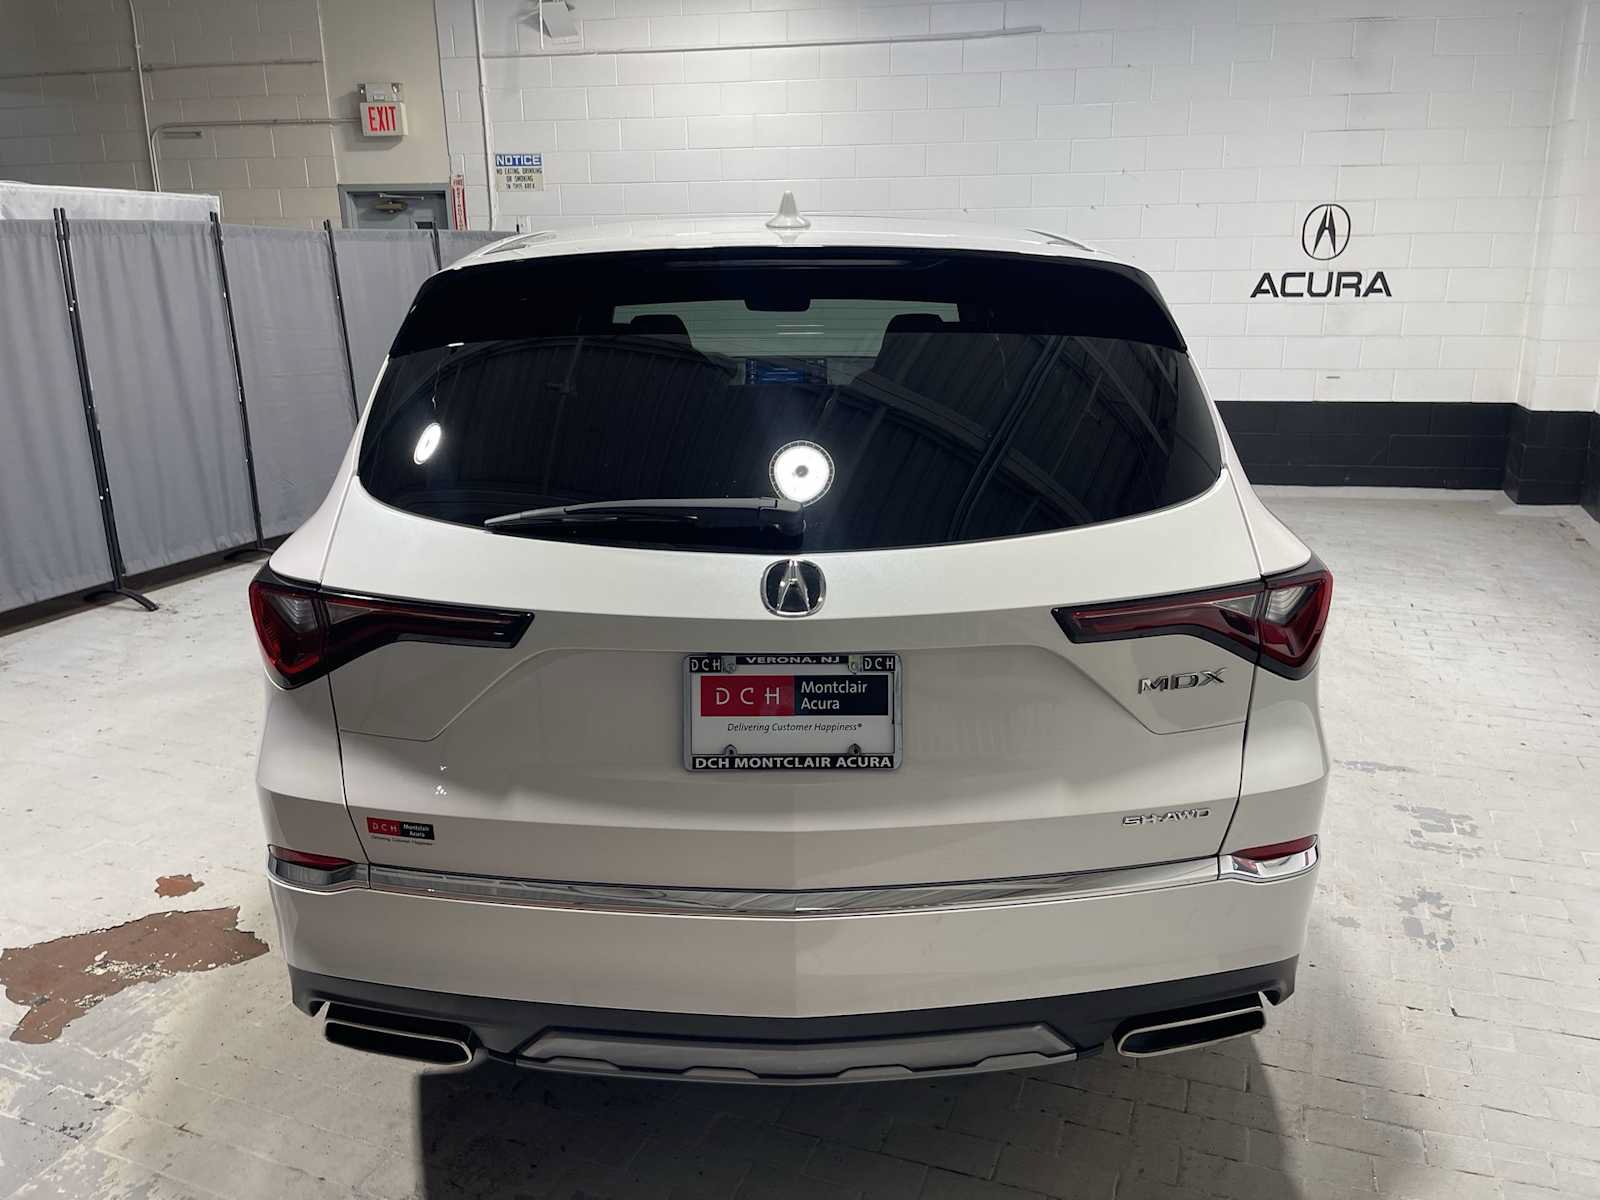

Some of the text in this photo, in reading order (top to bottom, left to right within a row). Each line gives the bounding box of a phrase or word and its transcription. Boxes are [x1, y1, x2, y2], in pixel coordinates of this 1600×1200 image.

[367, 106, 396, 131] EXIT
[496, 155, 541, 165] NOTICE
[1250, 271, 1392, 298] ACURA
[691, 659, 720, 671] DCH
[864, 657, 894, 669] DCH
[800, 680, 868, 693] Montclair
[1138, 667, 1227, 694] MDX
[715, 687, 780, 705] DCH
[800, 697, 840, 709] Acura
[727, 723, 770, 733] Delivering
[772, 723, 813, 731] Customer
[695, 756, 892, 769] DCH MONTCLAIR ACURA
[1122, 808, 1211, 825] SH-AWD
[372, 822, 398, 833] DCH
